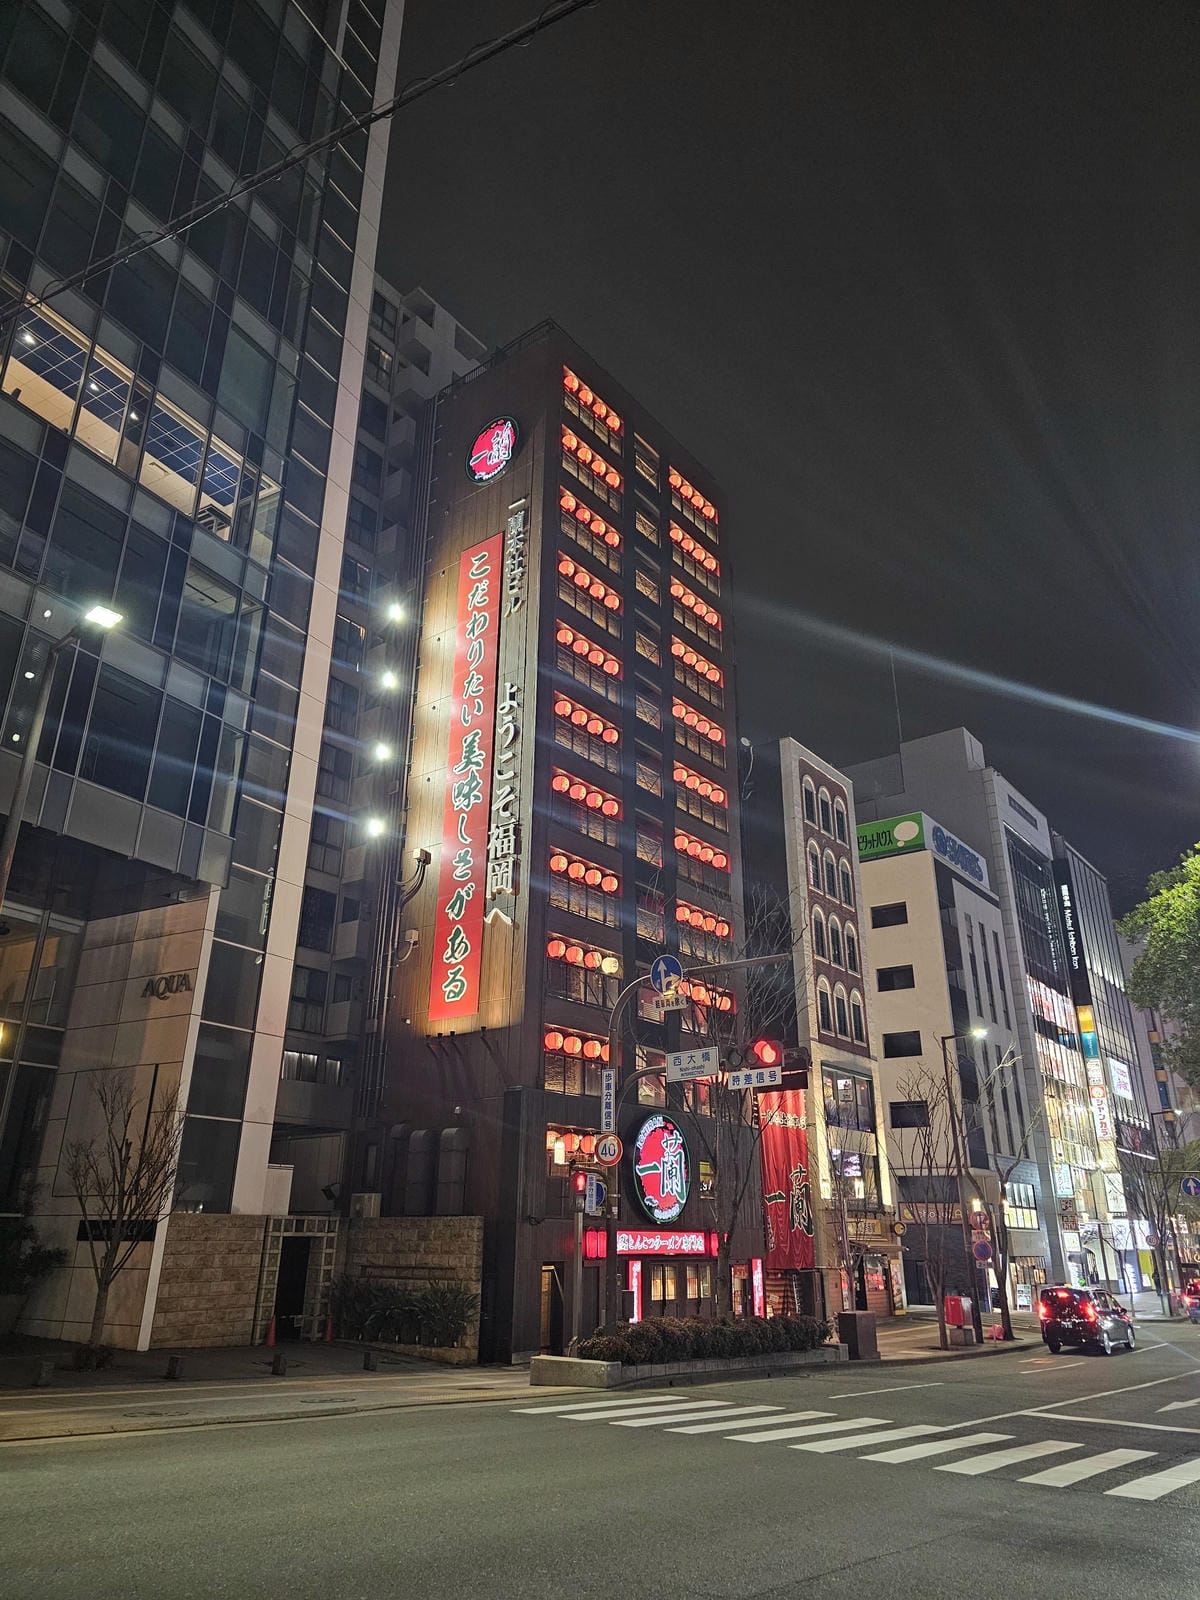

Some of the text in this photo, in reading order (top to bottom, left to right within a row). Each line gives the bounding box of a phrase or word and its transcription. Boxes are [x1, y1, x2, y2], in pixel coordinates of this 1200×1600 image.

[441, 552, 490, 1003] こだわりたい美味しさがある
[484, 682, 519, 925] ようこそ福岡へ
[141, 973, 193, 1000] AQUA
[673, 1051, 711, 1066] 西大橋
[732, 1070, 778, 1086] 時差信号
[604, 1072, 613, 1130] 歩車分離信号
[600, 1143, 616, 1157] 40
[636, 1130, 686, 1203] 一蘭
[765, 1163, 814, 1236] 一蘭
